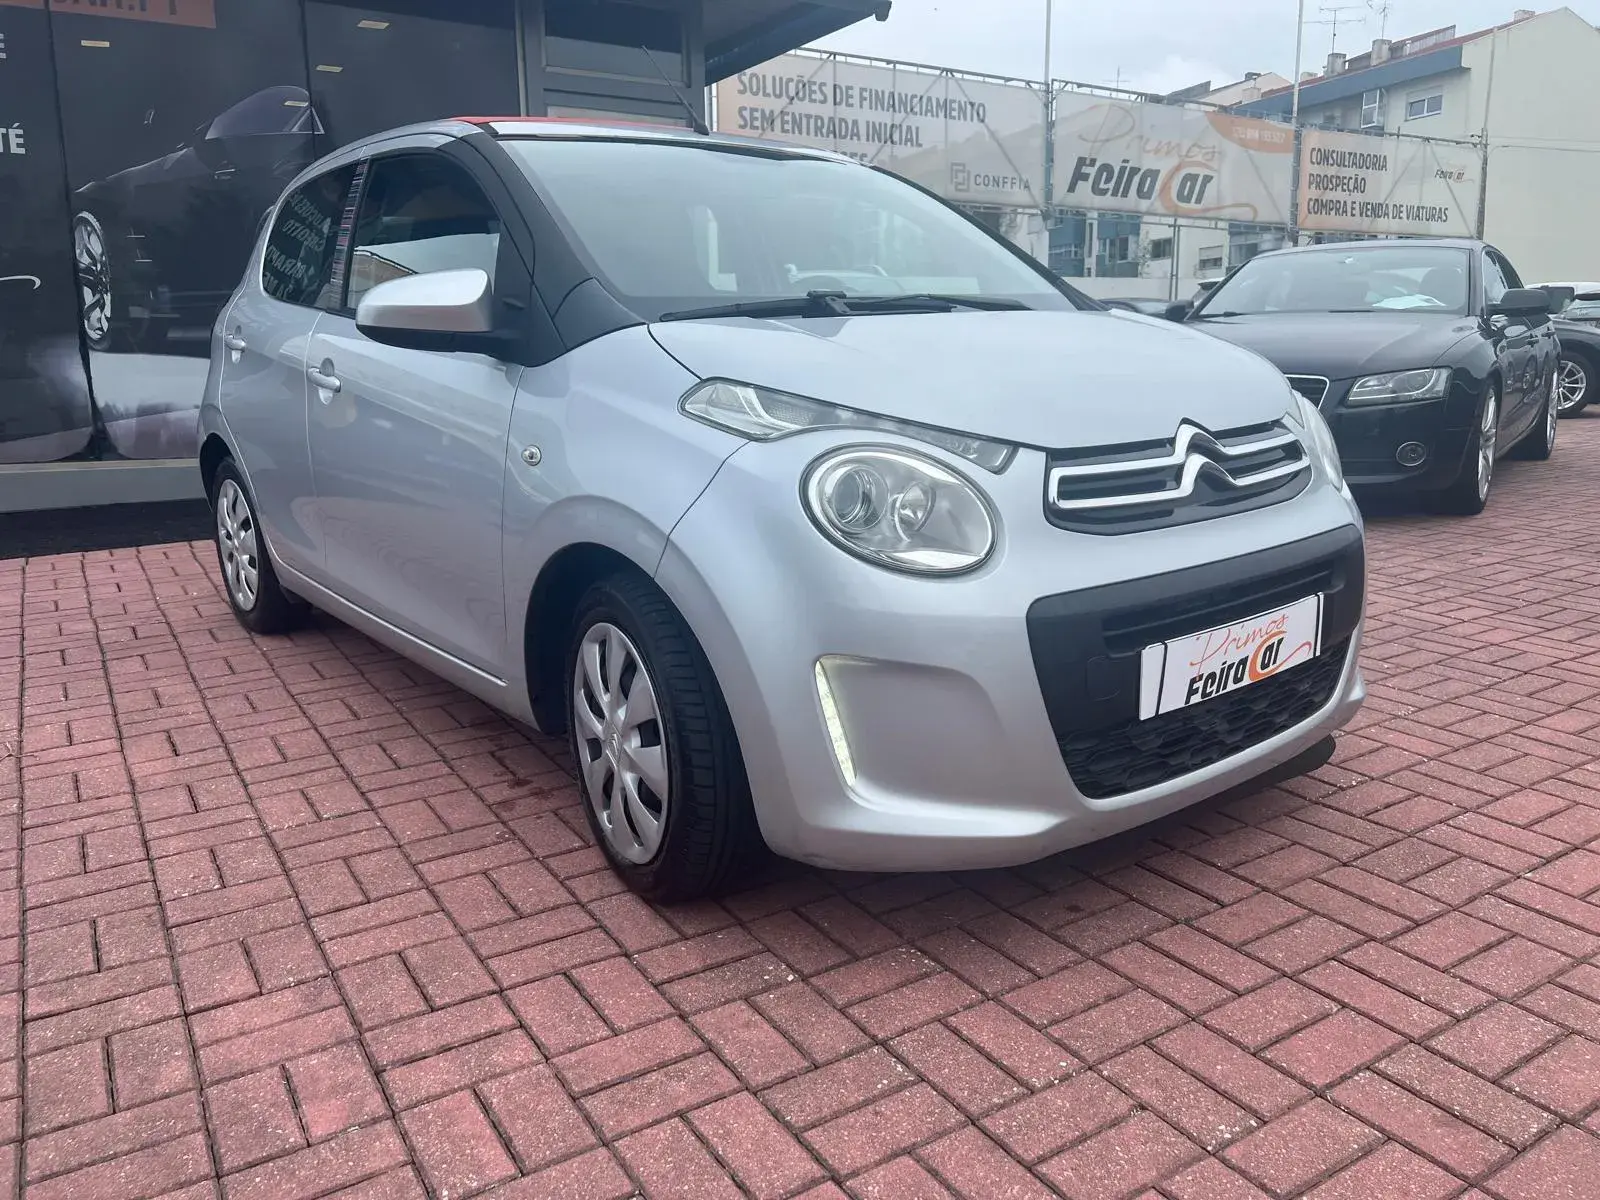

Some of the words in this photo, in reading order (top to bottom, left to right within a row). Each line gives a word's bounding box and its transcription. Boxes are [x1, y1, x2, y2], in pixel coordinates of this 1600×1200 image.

[737, 71, 828, 106] SOLUÇÕES
[832, 83, 855, 108] DE
[859, 87, 987, 123] FINANCIAMENTO
[737, 105, 776, 132] SEM
[780, 110, 861, 142] ENTRADA
[865, 120, 924, 148] INICIAL
[1309, 147, 1388, 172] CONSULTADORIA
[974, 173, 1030, 191] CONFFIA
[1308, 173, 1367, 196] PROSPEÇÃO
[1307, 198, 1348, 217] COMPRA
[1350, 200, 1357, 217] E
[1359, 202, 1389, 220] VENDA
[1391, 204, 1403, 220] DE
[1406, 205, 1449, 223] VIATURAS
[1189, 614, 1289, 682] Primos
